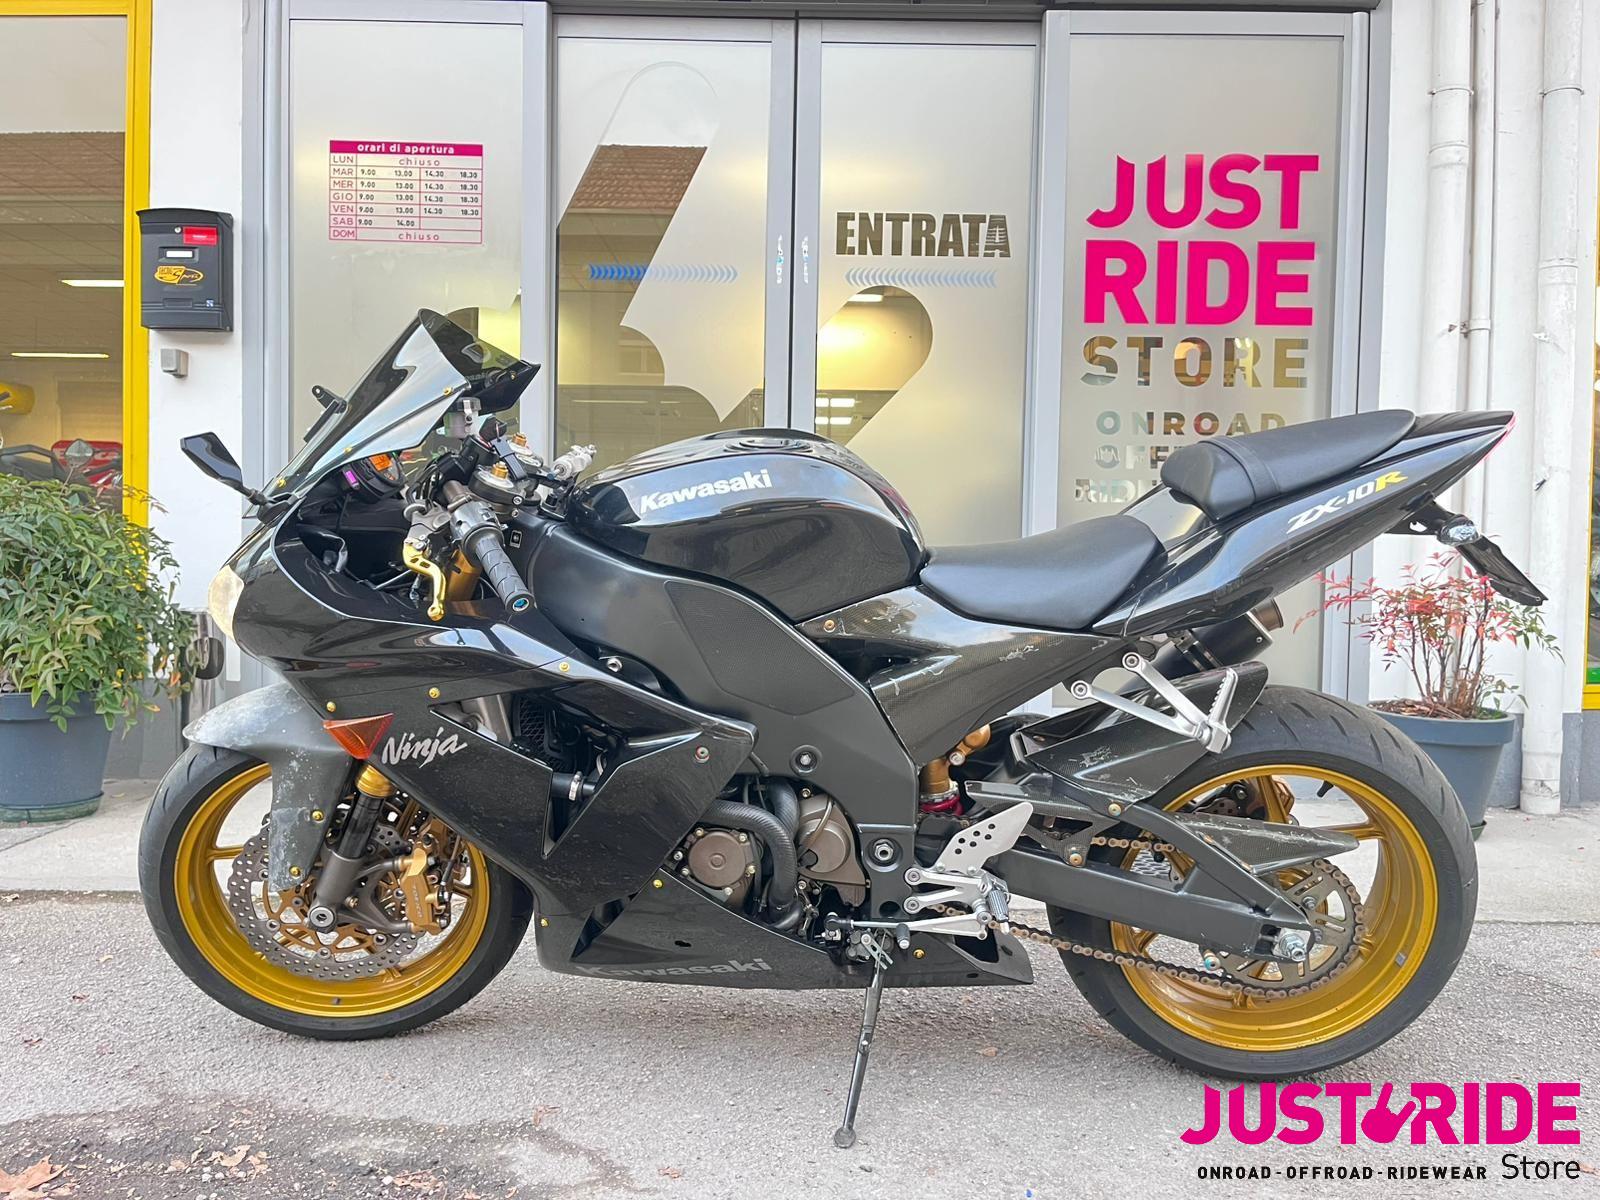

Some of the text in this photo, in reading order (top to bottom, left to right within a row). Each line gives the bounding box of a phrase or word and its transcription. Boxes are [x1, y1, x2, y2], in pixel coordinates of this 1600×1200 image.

[357, 143, 455, 155] orari di apertura
[333, 155, 440, 167] LUN chiuso
[333, 168, 354, 176] MAR
[333, 180, 353, 188] MER
[1086, 153, 1319, 229] JUST
[333, 192, 353, 201] GIO
[332, 205, 354, 213] VEN
[333, 217, 354, 226] SAB
[333, 230, 440, 240] DOM chiuso
[835, 212, 1011, 257] ENTRATA
[1084, 239, 1315, 326] RIDE
[1080, 335, 1309, 388] STORE
[1096, 410, 1286, 436] ONROAD
[639, 469, 773, 514] Kawasaki
[1286, 471, 1408, 534] ZX-10R
[381, 726, 468, 769] Ninja
[575, 958, 773, 977] Kawasaki
